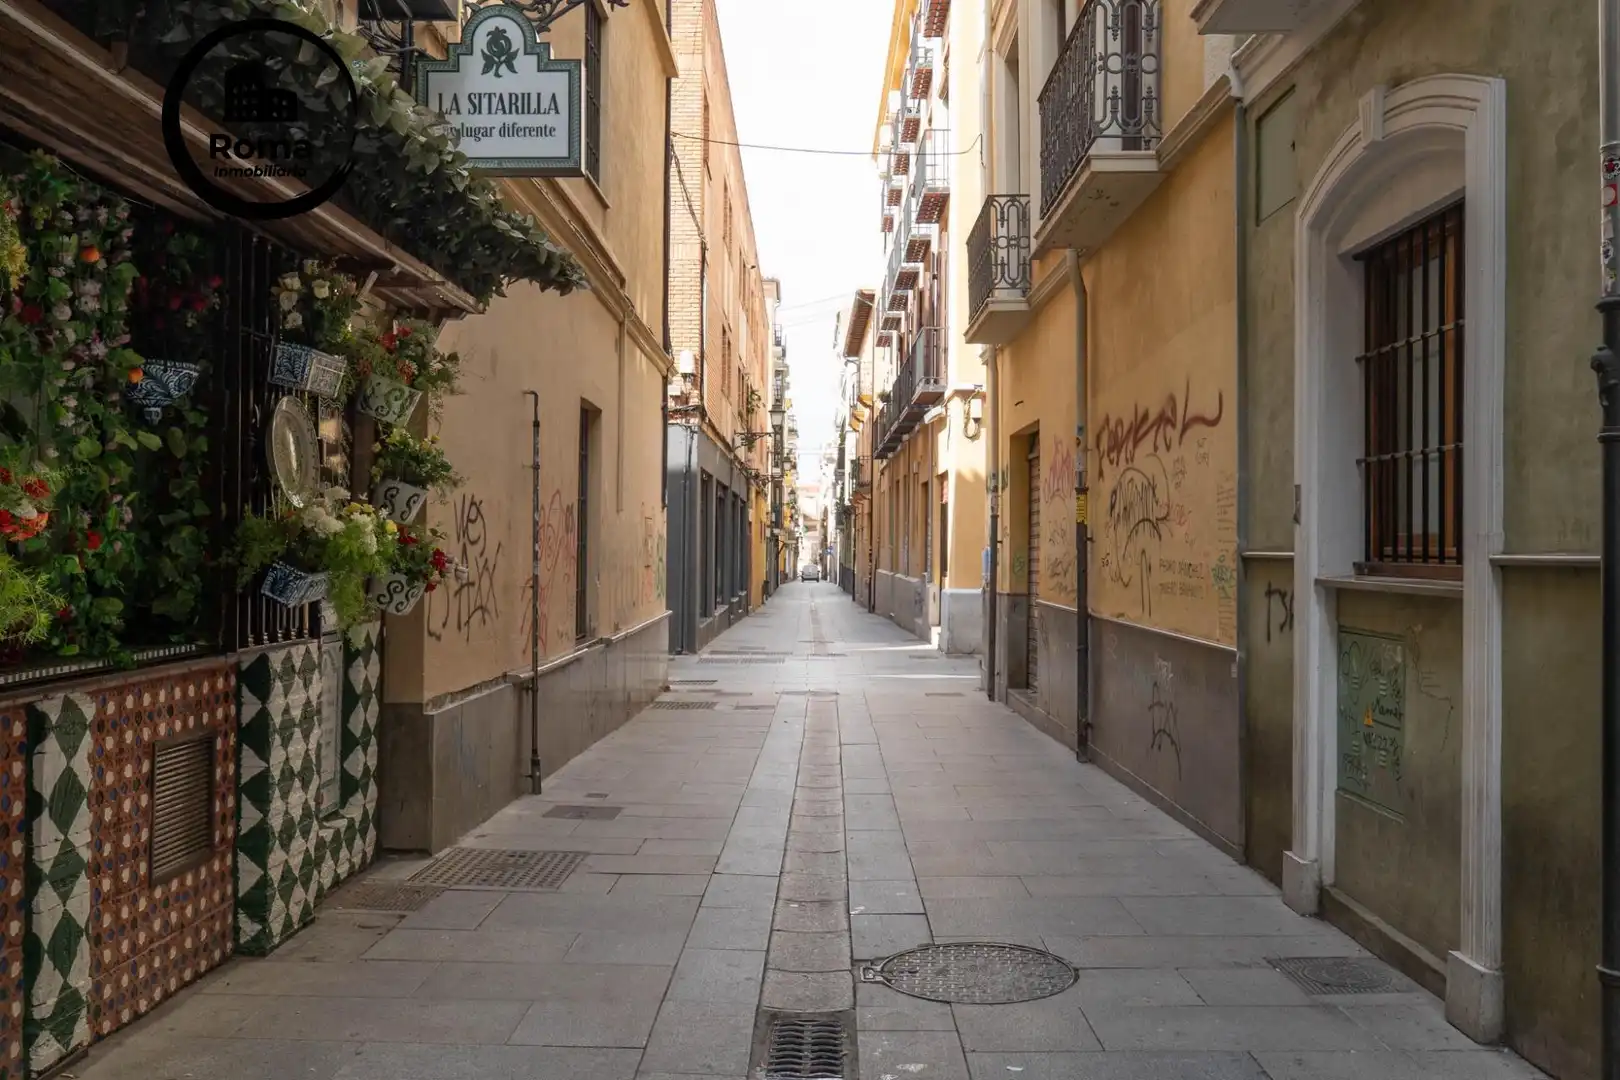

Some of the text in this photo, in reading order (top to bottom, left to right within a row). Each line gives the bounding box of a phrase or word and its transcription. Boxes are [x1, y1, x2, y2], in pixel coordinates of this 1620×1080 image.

[438, 92, 560, 115] LA SITARILLA
[461, 122, 496, 142] lugar
[499, 122, 556, 138] diferente
